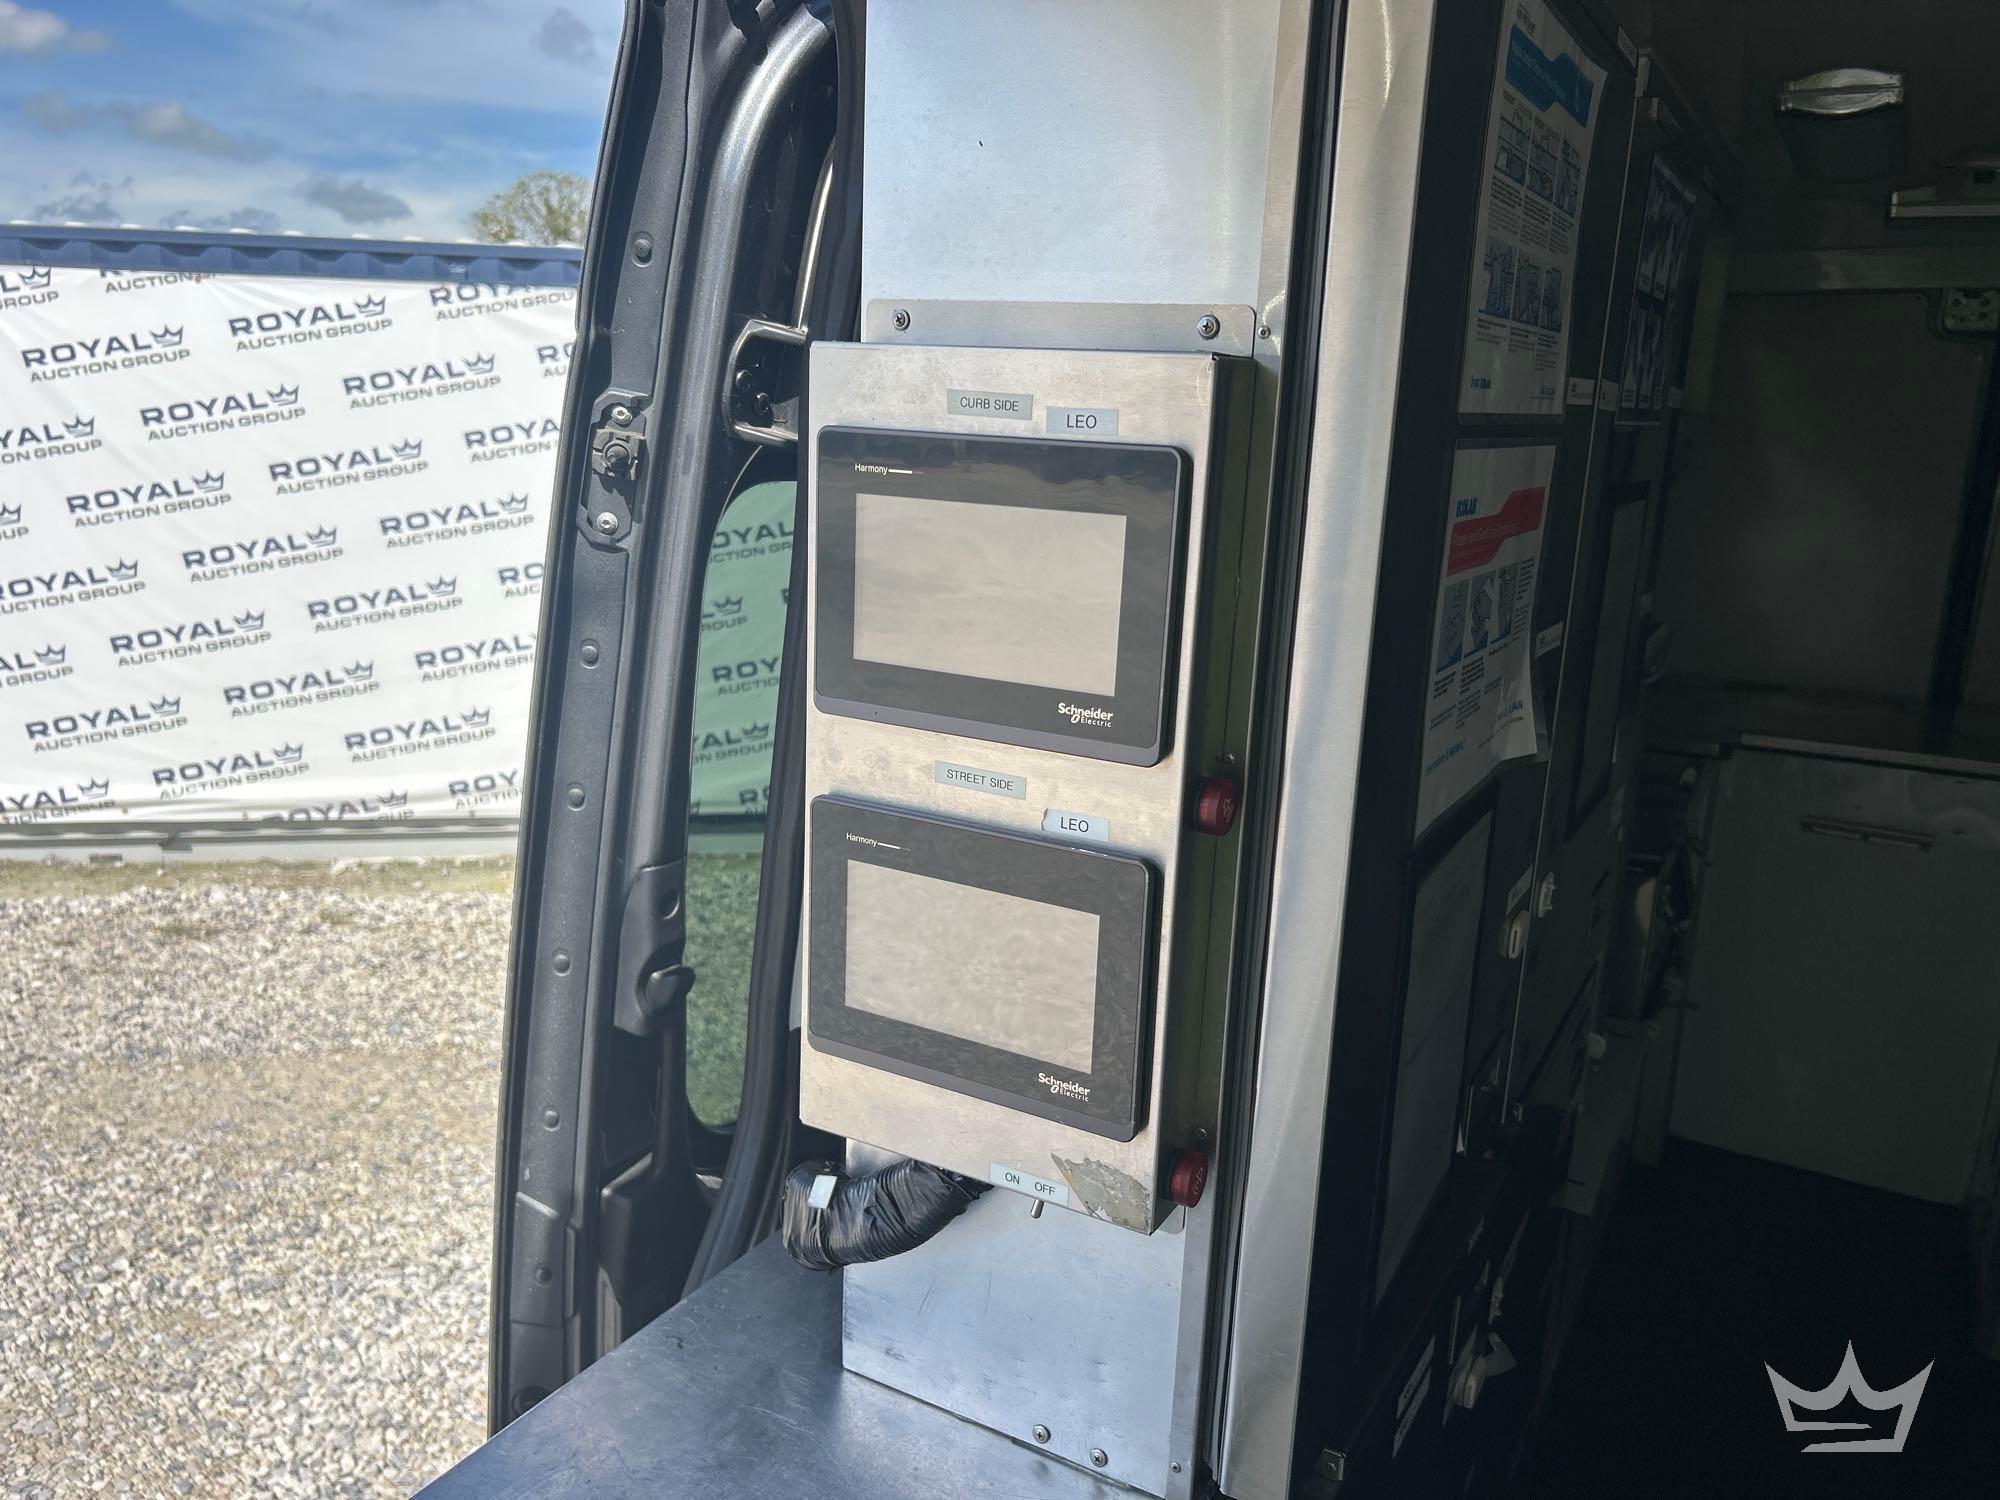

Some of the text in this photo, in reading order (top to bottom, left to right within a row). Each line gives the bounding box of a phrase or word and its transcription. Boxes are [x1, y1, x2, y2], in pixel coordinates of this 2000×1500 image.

[0, 291, 59, 311] ROUP
[436, 299, 518, 321] AUCTION
[229, 303, 356, 337] ROYAL
[236, 319, 393, 352] AUCTION GROUP
[21, 333, 152, 368] ROYAL
[31, 349, 191, 383] AUCTION GROUP
[343, 361, 465, 396] ROYAL
[350, 376, 502, 410] AUCTION GROUP
[140, 392, 269, 427] ROYAL
[959, 396, 1019, 412] CURB SIDE
[148, 407, 305, 441] AUCTION GROUP
[1066, 414, 1097, 429] LEO
[34, 439, 102, 460] GROUP
[269, 448, 392, 481] ROYAL
[471, 440, 550, 462] AUCTION
[276, 460, 428, 496] AUCTION GROUP
[854, 463, 888, 475] Harmony
[66, 480, 194, 514] ROYAL
[75, 493, 232, 528] AUCTION GROUP
[380, 501, 499, 535] ROYAL
[387, 514, 534, 549] AUCTION GROUP
[183, 534, 307, 569] ROYAL
[191, 547, 343, 582] AUCTION GROUP
[0, 567, 108, 598] OYAL
[0, 581, 146, 615] UCTION GROUP
[307, 585, 428, 619] ROYAL
[315, 597, 463, 633] AUCTION GROUP
[110, 618, 235, 653] ROYAL
[118, 631, 272, 667] AUCTION GROUP
[415, 635, 532, 669] ROYAL
[6, 666, 73, 687] GROUP
[224, 669, 345, 704] ROYAL
[422, 658, 500, 682] AUCTION
[231, 681, 380, 718] AUCTION GROUP
[1057, 702, 1114, 721] Schneider
[26, 704, 151, 739] ROYAL
[33, 716, 188, 753] AUCTION GROUP
[344, 715, 462, 749] ROYAL
[1080, 716, 1112, 728] Electric
[352, 728, 496, 763] AUCTION GROUP
[152, 751, 274, 786] ROYAL
[159, 762, 309, 801] AUCTION GROUP
[946, 769, 1014, 791] STREET SIDE
[846, 832, 878, 847] Harmony
[1060, 816, 1090, 833] LEO
[1038, 1072, 1091, 1096] Schneider
[1060, 1088, 1089, 1102] Electric
[1005, 1172, 1056, 1195] ON OFF
